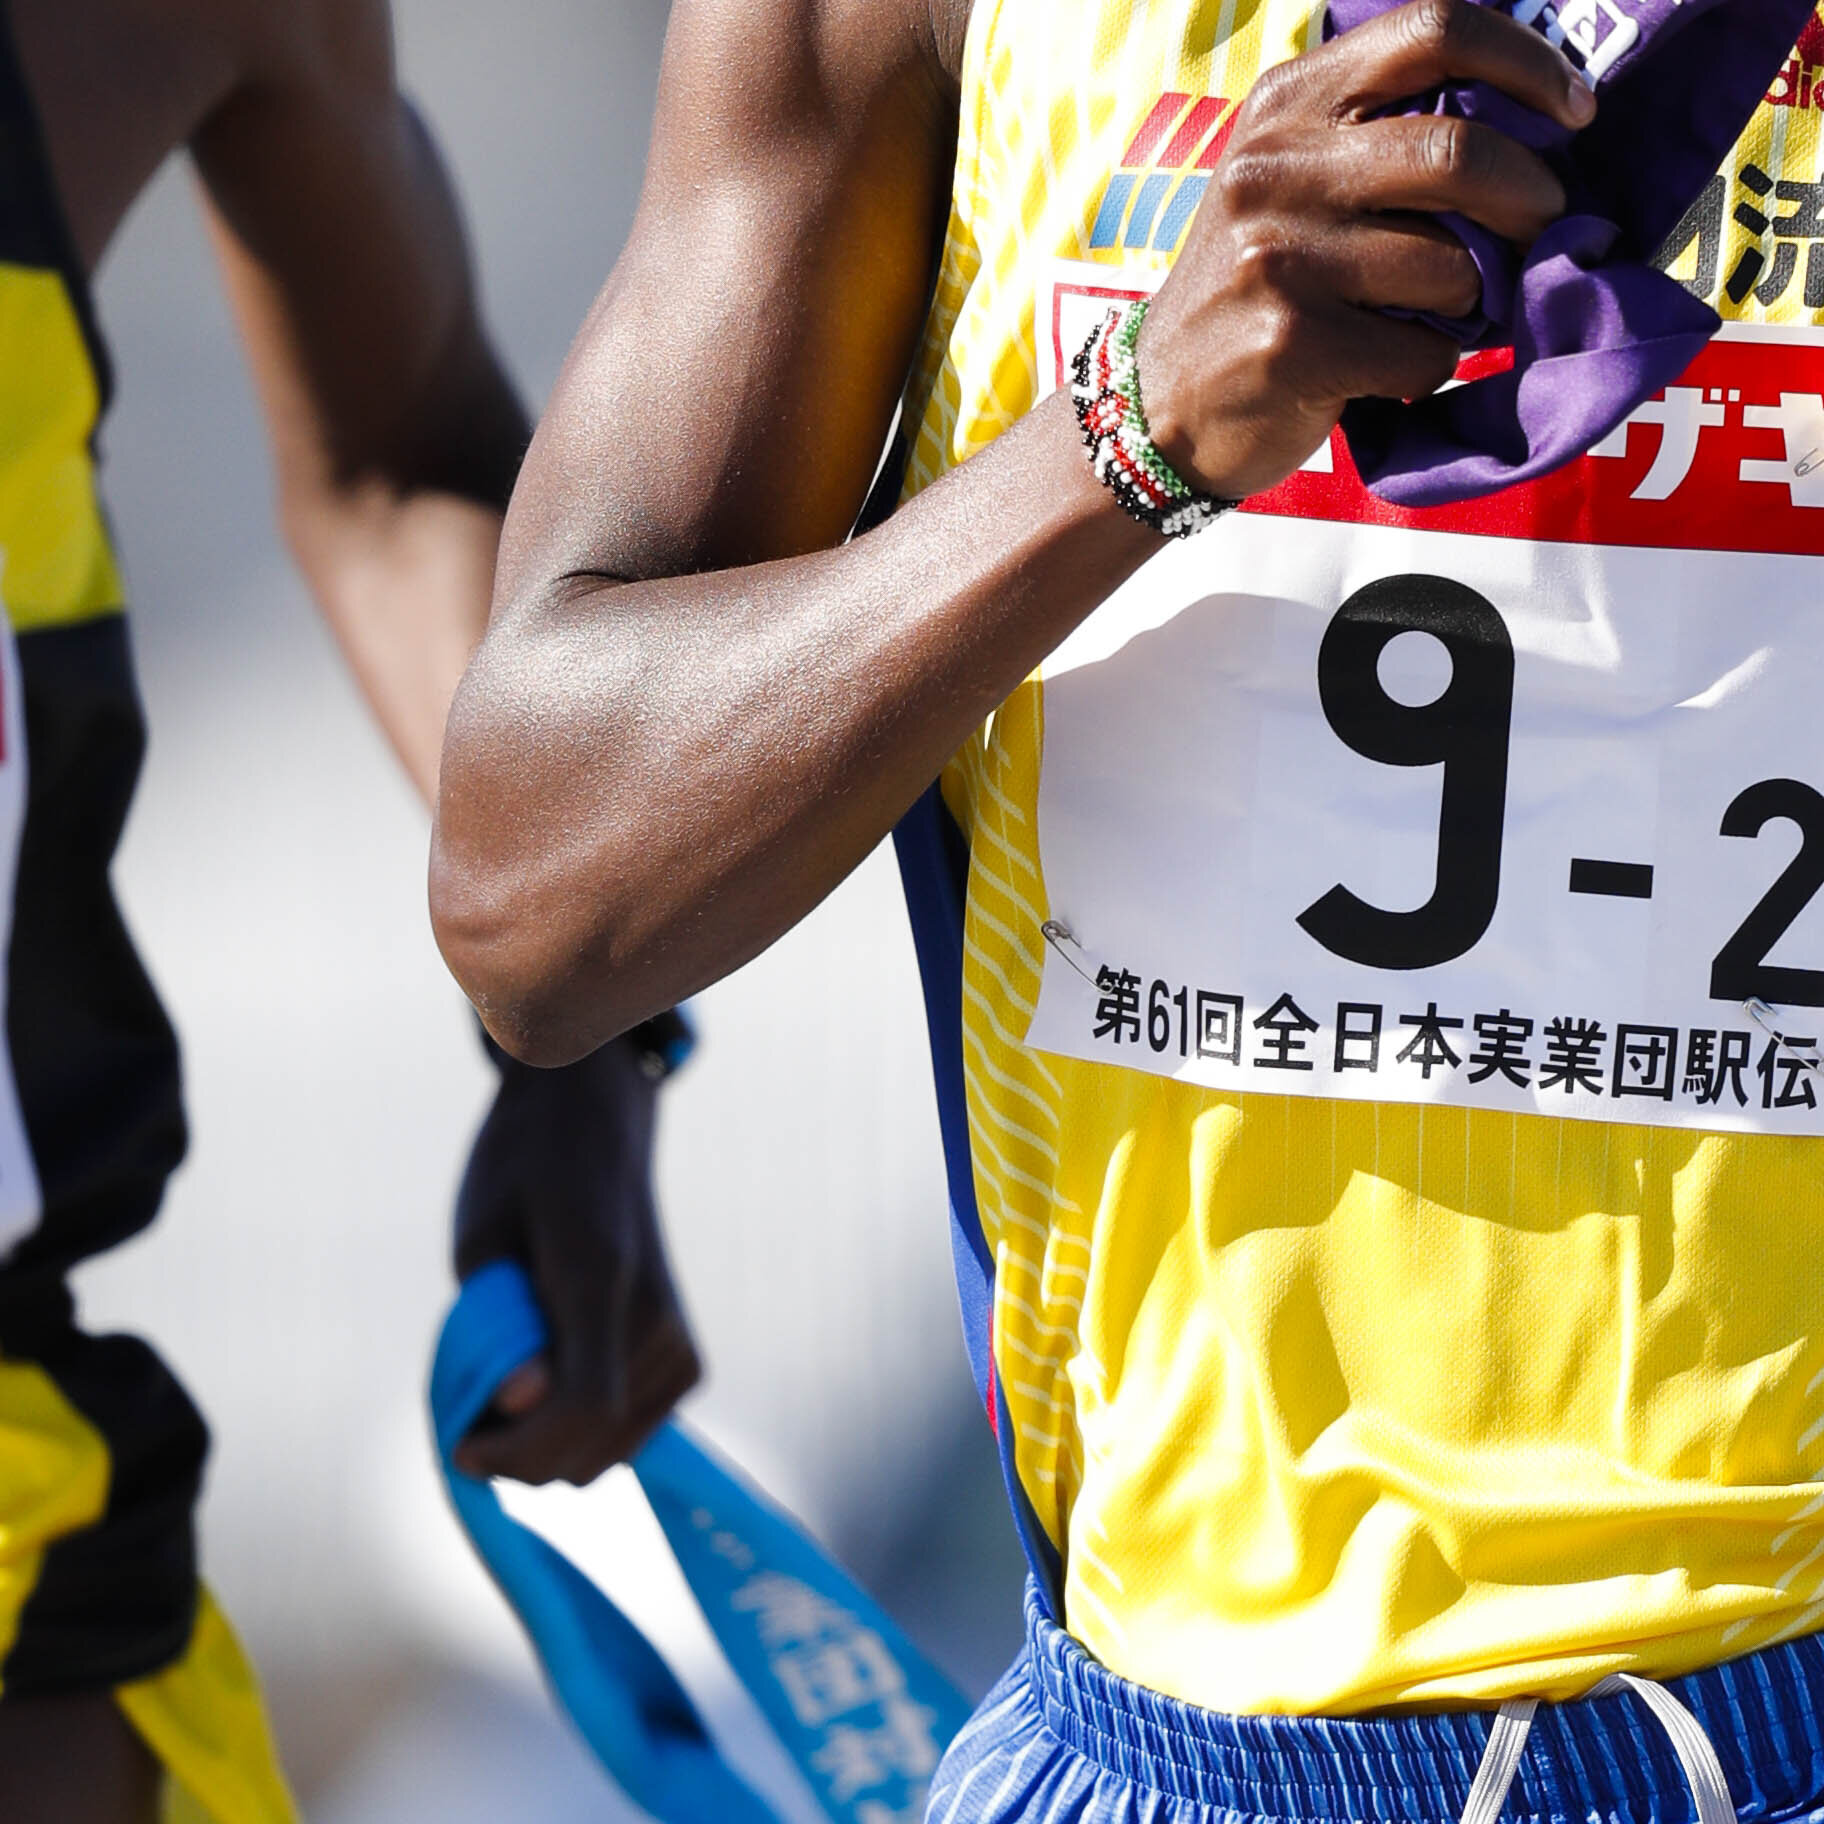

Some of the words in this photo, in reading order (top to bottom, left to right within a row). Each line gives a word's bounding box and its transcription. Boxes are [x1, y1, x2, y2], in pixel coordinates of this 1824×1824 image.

[1091, 964, 1822, 1111] 第61回全日本実業団駅伝
